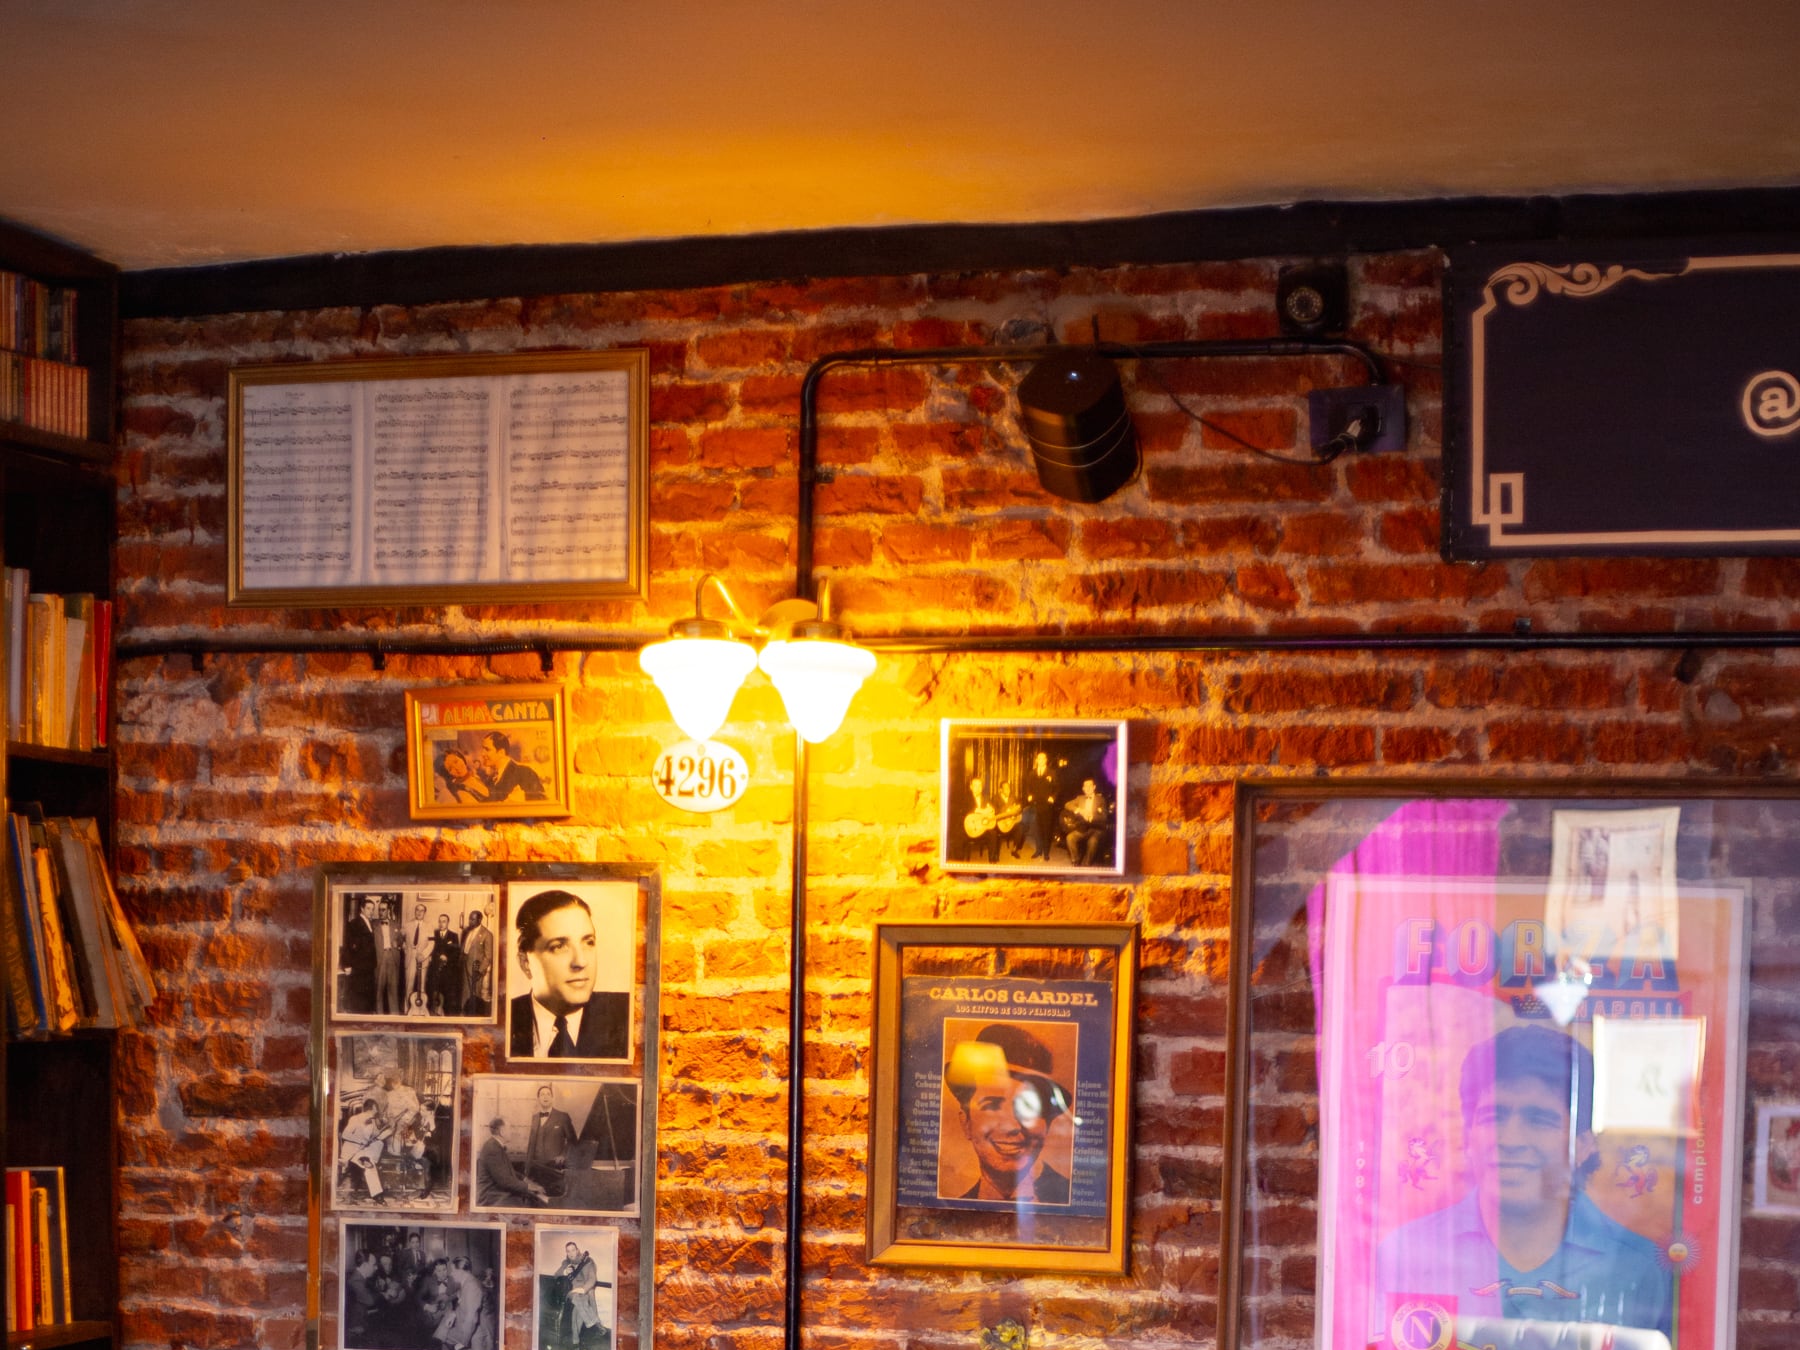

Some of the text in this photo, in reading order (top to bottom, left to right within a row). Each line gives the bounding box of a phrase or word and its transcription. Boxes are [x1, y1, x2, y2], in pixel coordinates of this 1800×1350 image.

[491, 701, 549, 721] CANTA
[658, 755, 736, 799] 4296
[929, 986, 1098, 1007] CARLOS GARDEL
[1367, 1041, 1416, 1080] 10
